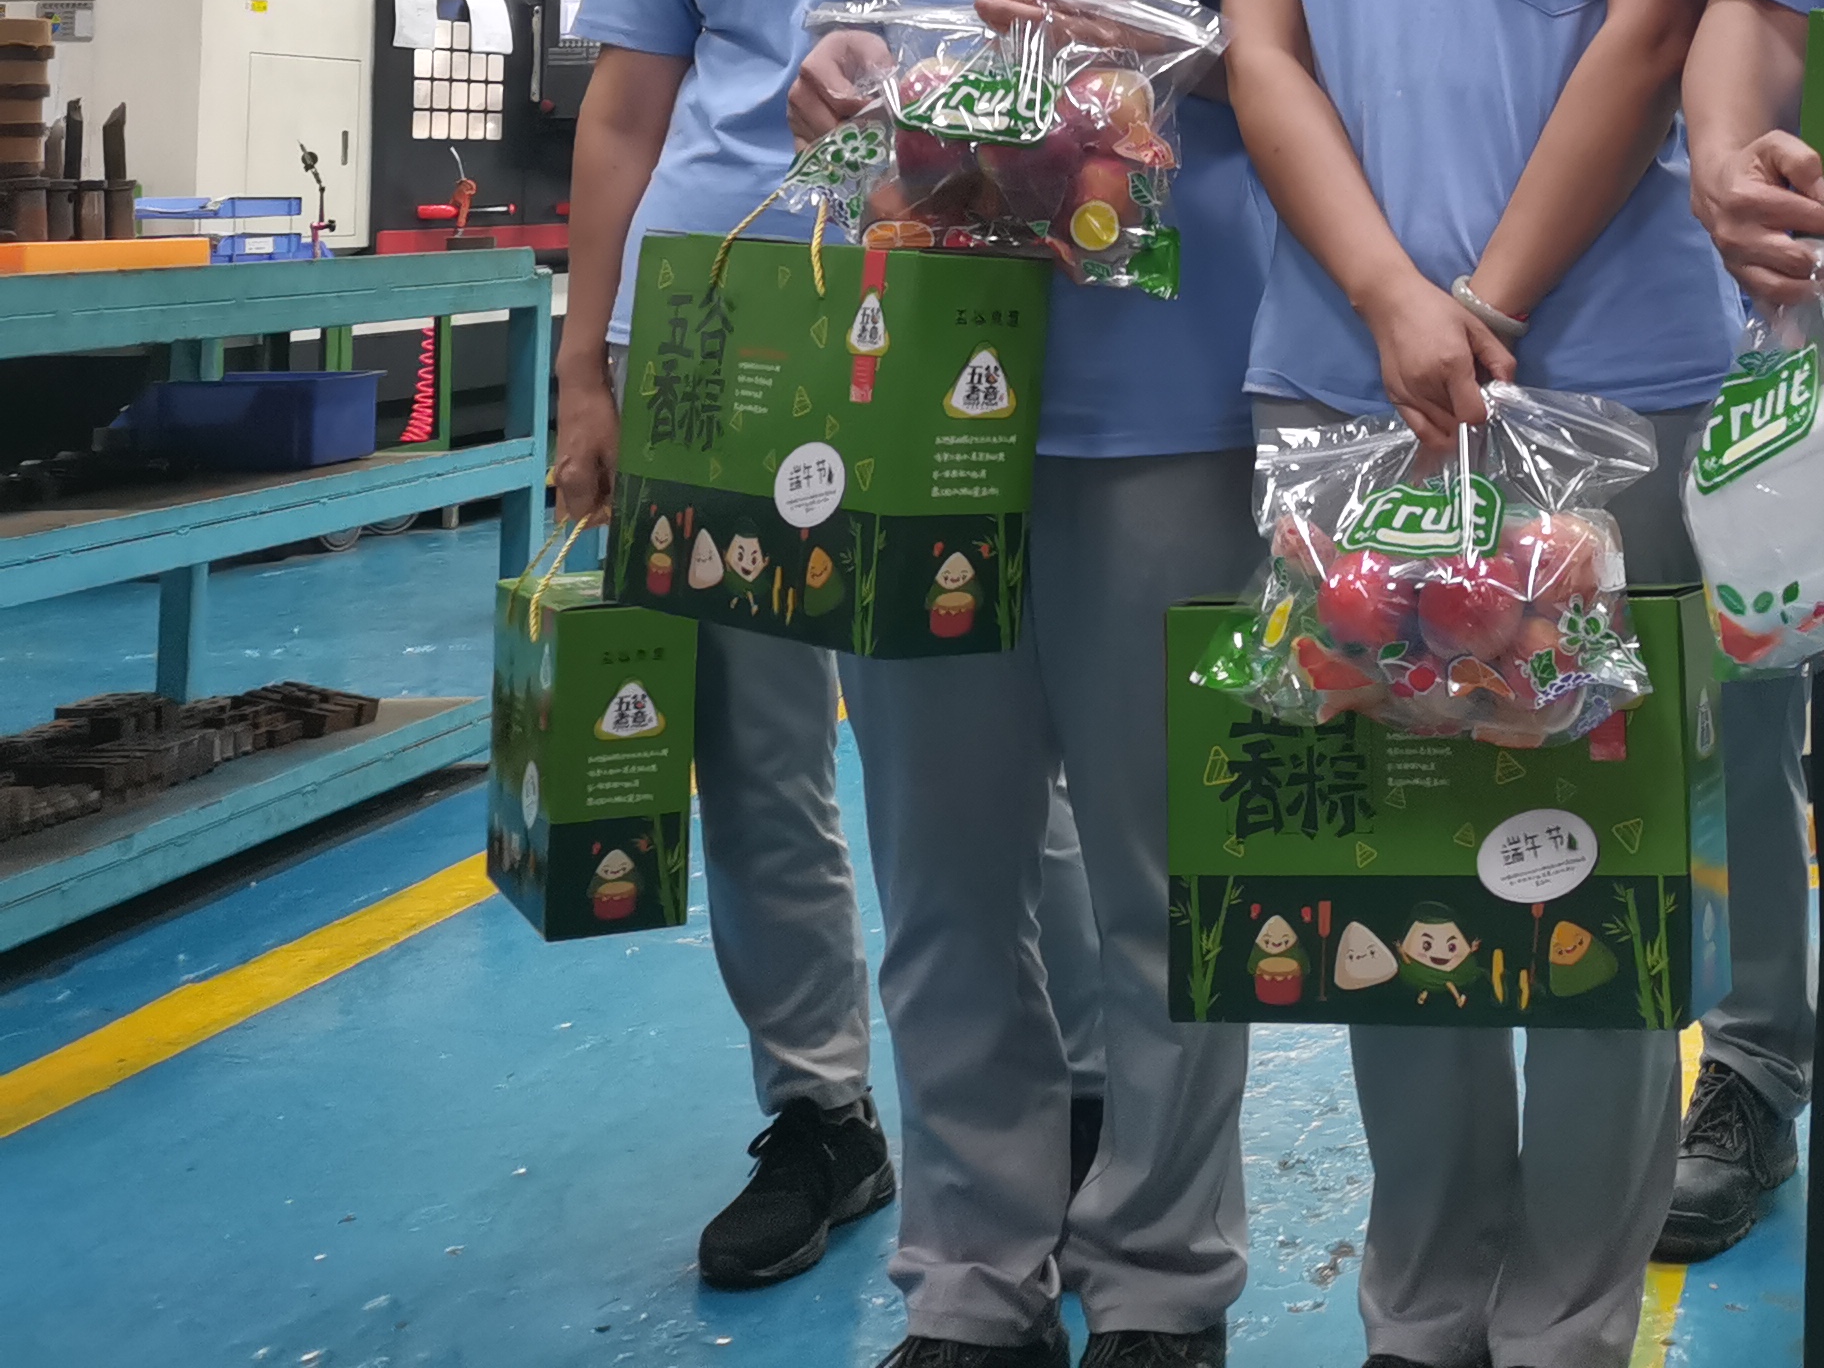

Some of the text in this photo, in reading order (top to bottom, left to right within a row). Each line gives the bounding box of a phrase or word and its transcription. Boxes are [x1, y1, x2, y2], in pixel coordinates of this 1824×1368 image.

[920, 76, 1037, 119] ruit
[657, 286, 735, 366] 五谷
[647, 358, 727, 452] 香粽
[788, 458, 827, 492] 端午节
[1363, 486, 1488, 532] Fruit
[1219, 739, 1377, 841] 香粽
[1500, 825, 1564, 867] 端午节
